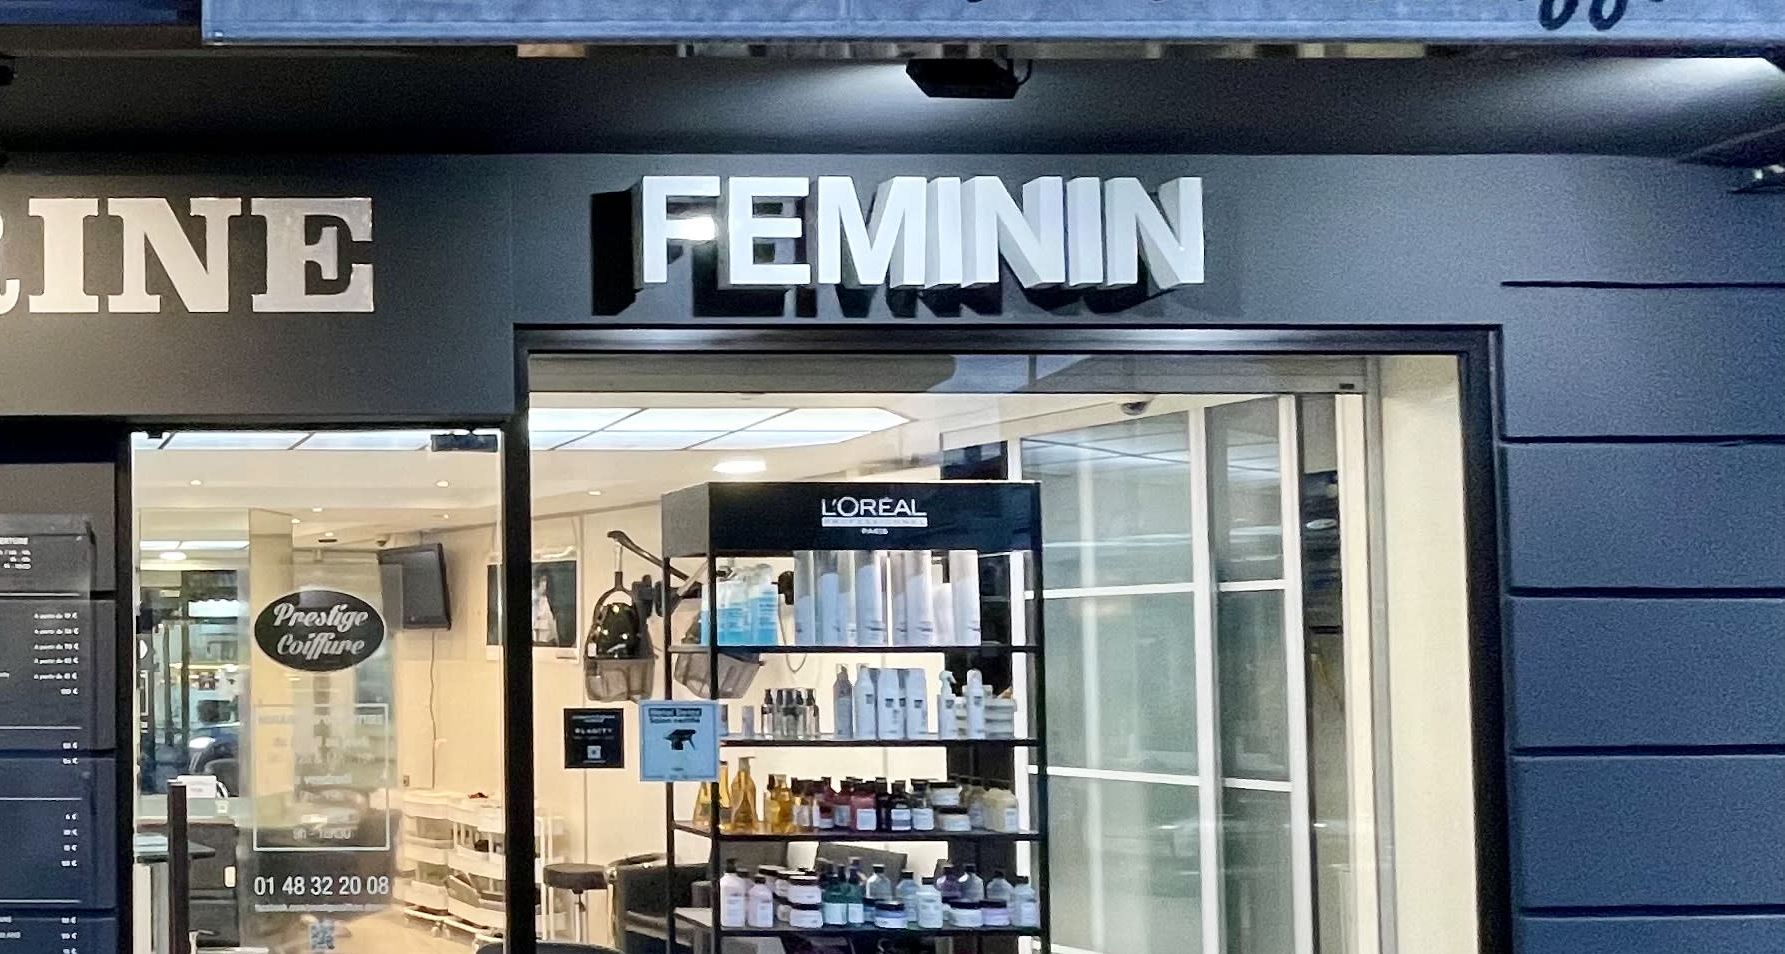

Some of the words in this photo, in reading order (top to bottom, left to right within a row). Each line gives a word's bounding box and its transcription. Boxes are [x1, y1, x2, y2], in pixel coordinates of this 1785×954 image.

[642, 174, 1205, 290] FEMININ
[821, 496, 928, 517] L'ORÉAL
[273, 602, 369, 632] Prestige
[276, 632, 365, 661] Coiffure
[254, 876, 274, 895] 01
[282, 876, 305, 895] 48
[310, 876, 333, 896] 32
[339, 876, 362, 895] 20
[367, 876, 389, 895] 08
